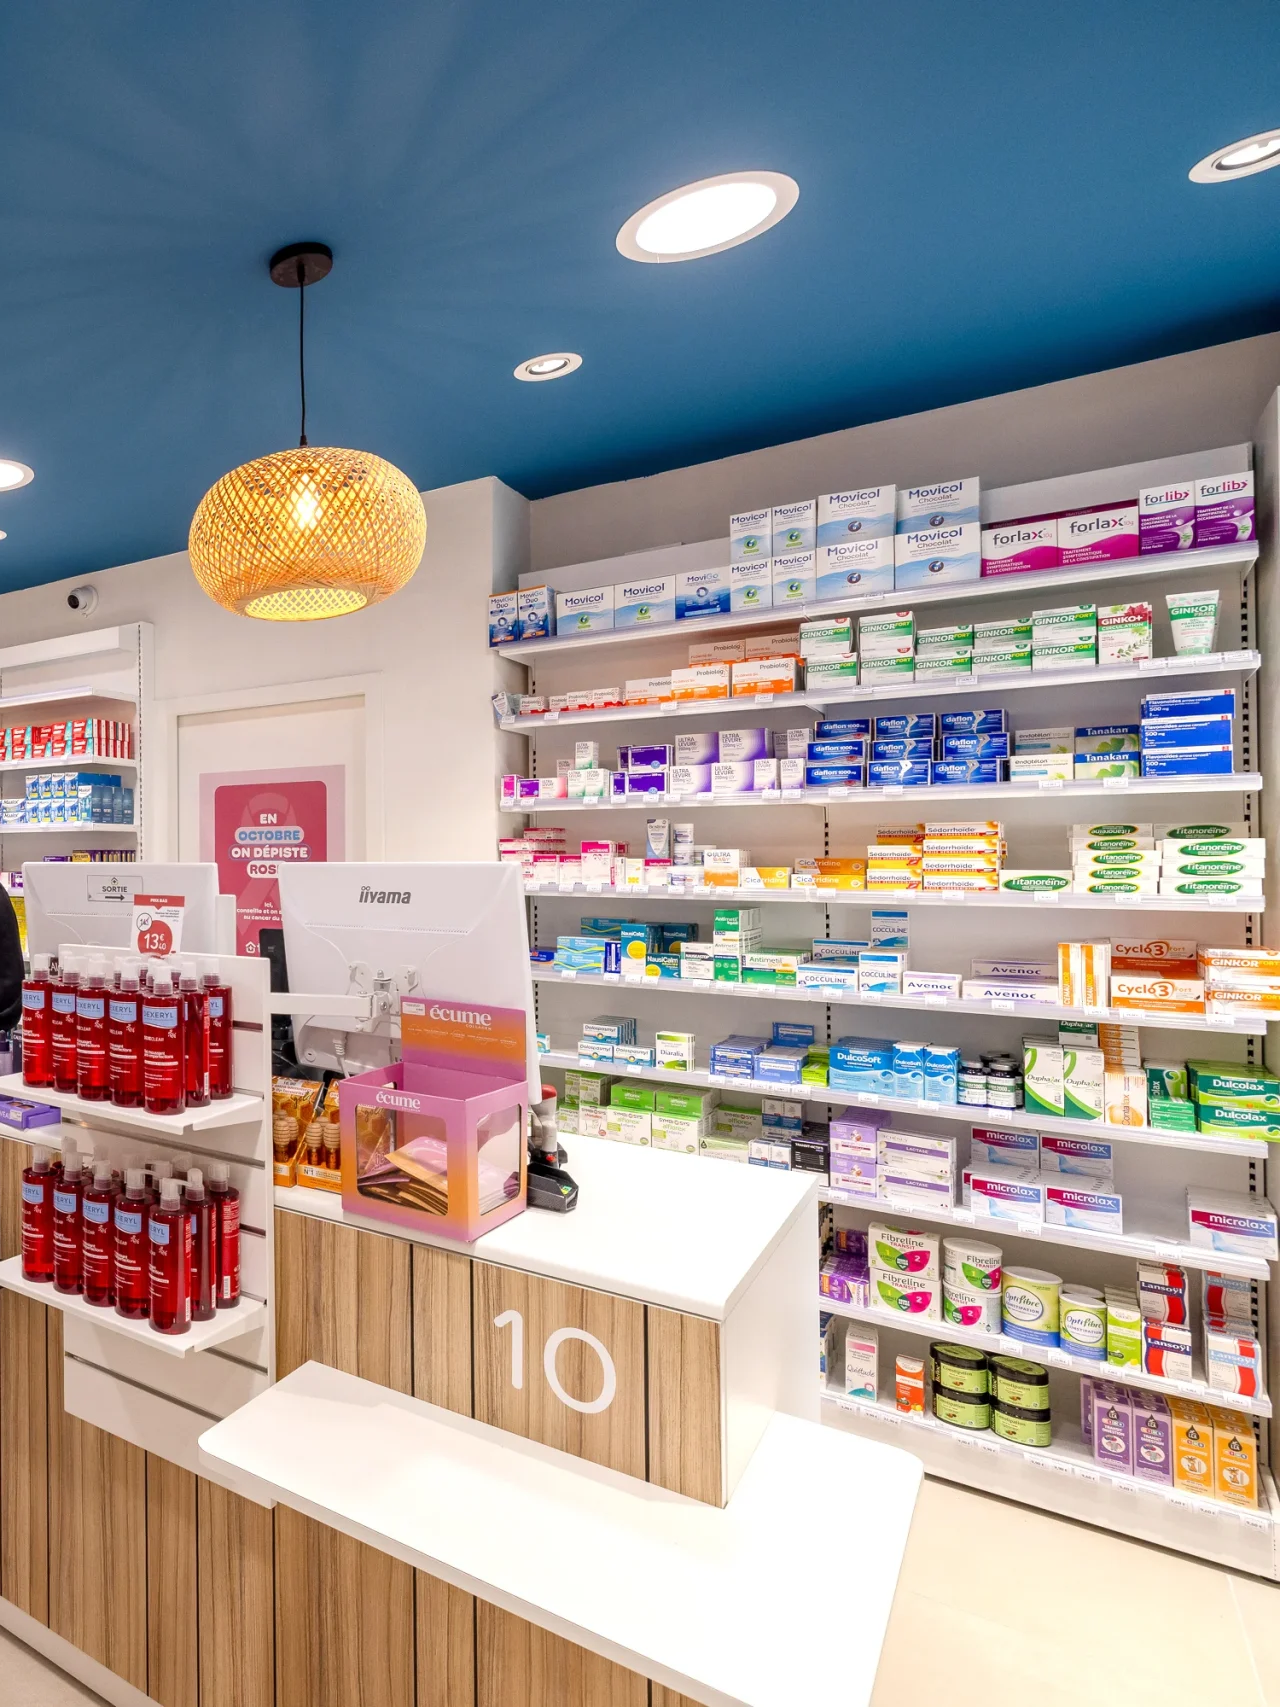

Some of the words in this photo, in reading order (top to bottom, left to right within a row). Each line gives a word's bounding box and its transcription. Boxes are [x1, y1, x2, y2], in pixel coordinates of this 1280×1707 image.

[829, 489, 880, 504] Movicol
[908, 482, 963, 500] Movicol
[838, 500, 871, 510] Chocolat
[917, 493, 953, 505] Chocolat
[774, 503, 811, 516] Movicol
[731, 512, 768, 525] Movicol
[1069, 517, 1124, 535] forlax
[907, 527, 963, 545] Movicol
[993, 529, 1044, 546] forlax
[827, 541, 878, 557] Movicol
[917, 540, 953, 550] Chocolat
[836, 552, 869, 562] Chocolat
[1062, 548, 1091, 557] TRAITEMENT
[1062, 551, 1102, 561] SYMPTOMATIQUE
[774, 554, 811, 567] Movicol
[986, 558, 1014, 567] TRAITEMENT
[731, 562, 768, 574] Movicol
[624, 583, 665, 598] Movicol
[565, 593, 604, 607] Movicol
[1171, 605, 1216, 616] GINKOR
[1035, 615, 1075, 627] GINKOR
[1101, 614, 1143, 626] GINKO+
[861, 622, 895, 635] GINKOR
[649, 678, 671, 688] Probiolo
[881, 718, 906, 728] daflon
[946, 714, 973, 724] daflon
[824, 722, 847, 731] daflon
[1085, 726, 1128, 737] Tanakan
[879, 744, 903, 753] daflon
[949, 739, 977, 749] daflon
[1084, 753, 1129, 763] Tanakan
[873, 764, 900, 774] daflon
[938, 764, 966, 774] daflon
[260, 814, 277, 824] EN
[238, 830, 300, 841] OCTOBRE
[231, 847, 250, 858] ON
[253, 844, 308, 858] DÉPISTE
[250, 864, 279, 875] ROS
[796, 876, 839, 885] Cicatridine
[359, 886, 411, 904] iiyama
[1115, 942, 1153, 956] Cyclo
[1211, 958, 1259, 969] GINKOR
[991, 965, 1041, 976] Avenoc
[907, 981, 953, 991] Avenoc
[1117, 983, 1154, 997] Cyclo
[983, 989, 1036, 1000] Avenoc
[429, 1004, 492, 1026] écume
[660, 1049, 684, 1058] Diaralia
[837, 1052, 881, 1065] DulcoSoft
[1213, 1079, 1264, 1092] Dulcolax
[376, 1091, 421, 1110] écume
[1215, 1110, 1267, 1123] Dulcolax
[986, 1130, 1035, 1145] microlax
[1057, 1138, 1107, 1154] microlax
[987, 1181, 1037, 1197] microlax
[1063, 1190, 1116, 1207] microlax
[1210, 1212, 1271, 1231] microlax
[890, 1241, 916, 1251] TRANSIT
[914, 1254, 921, 1263] 2
[891, 1282, 917, 1292] TRANSIT
[1141, 1281, 1184, 1296] Lansoyl
[916, 1296, 923, 1304] 2
[1006, 1291, 1040, 1309] Optifibre
[1147, 1337, 1190, 1354] Lansoyl
[493, 1309, 617, 1414] 10
